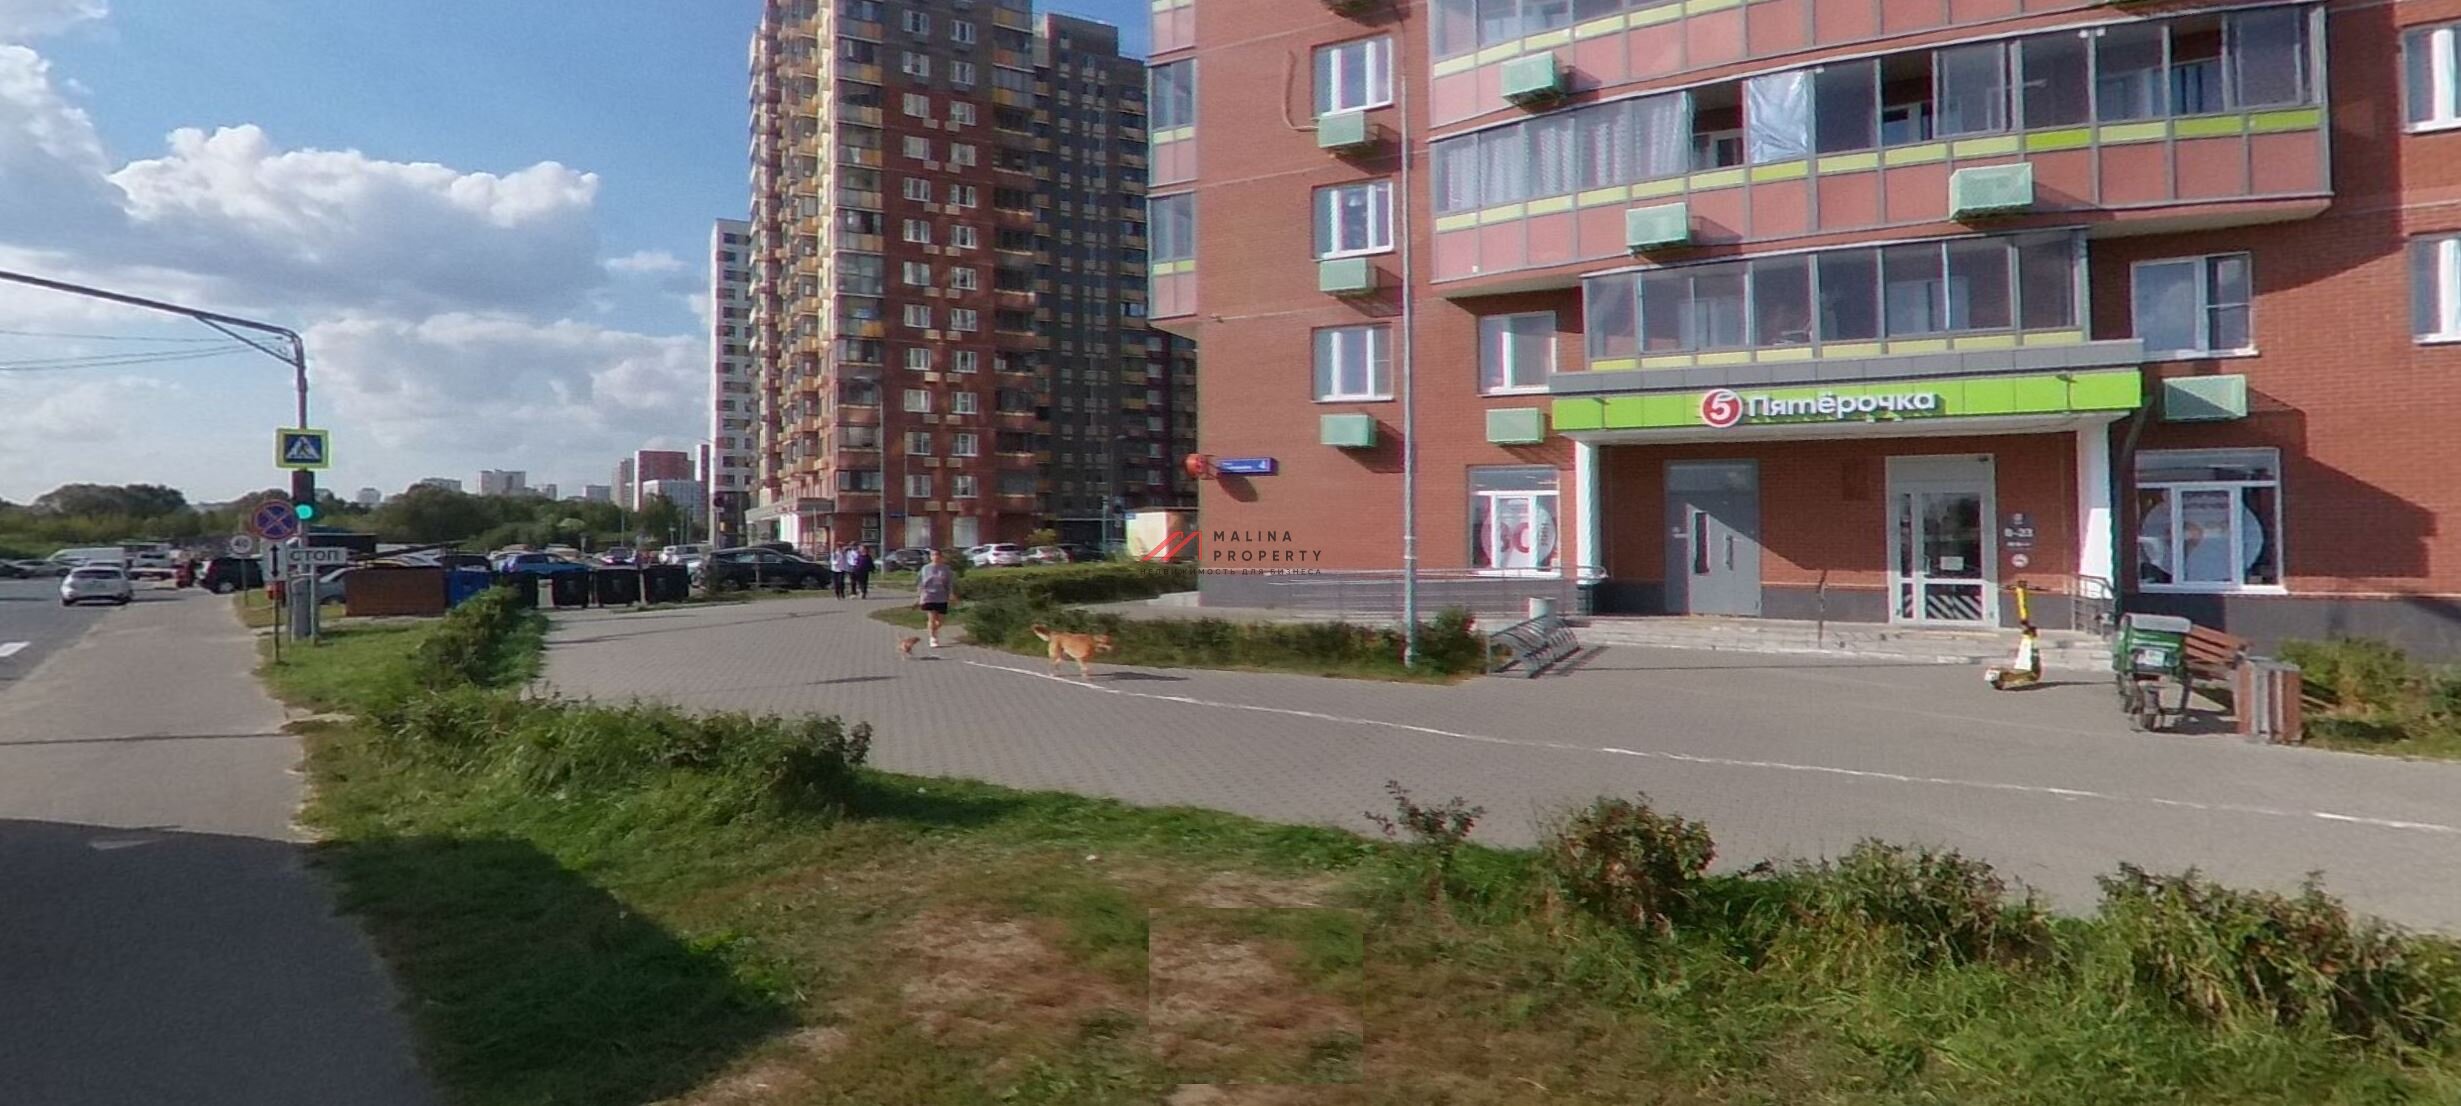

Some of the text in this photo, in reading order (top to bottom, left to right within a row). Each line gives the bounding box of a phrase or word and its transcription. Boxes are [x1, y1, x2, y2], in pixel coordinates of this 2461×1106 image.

[1710, 390, 1936, 420] 5 Пятёрочка
[289, 550, 338, 561] СТОП
